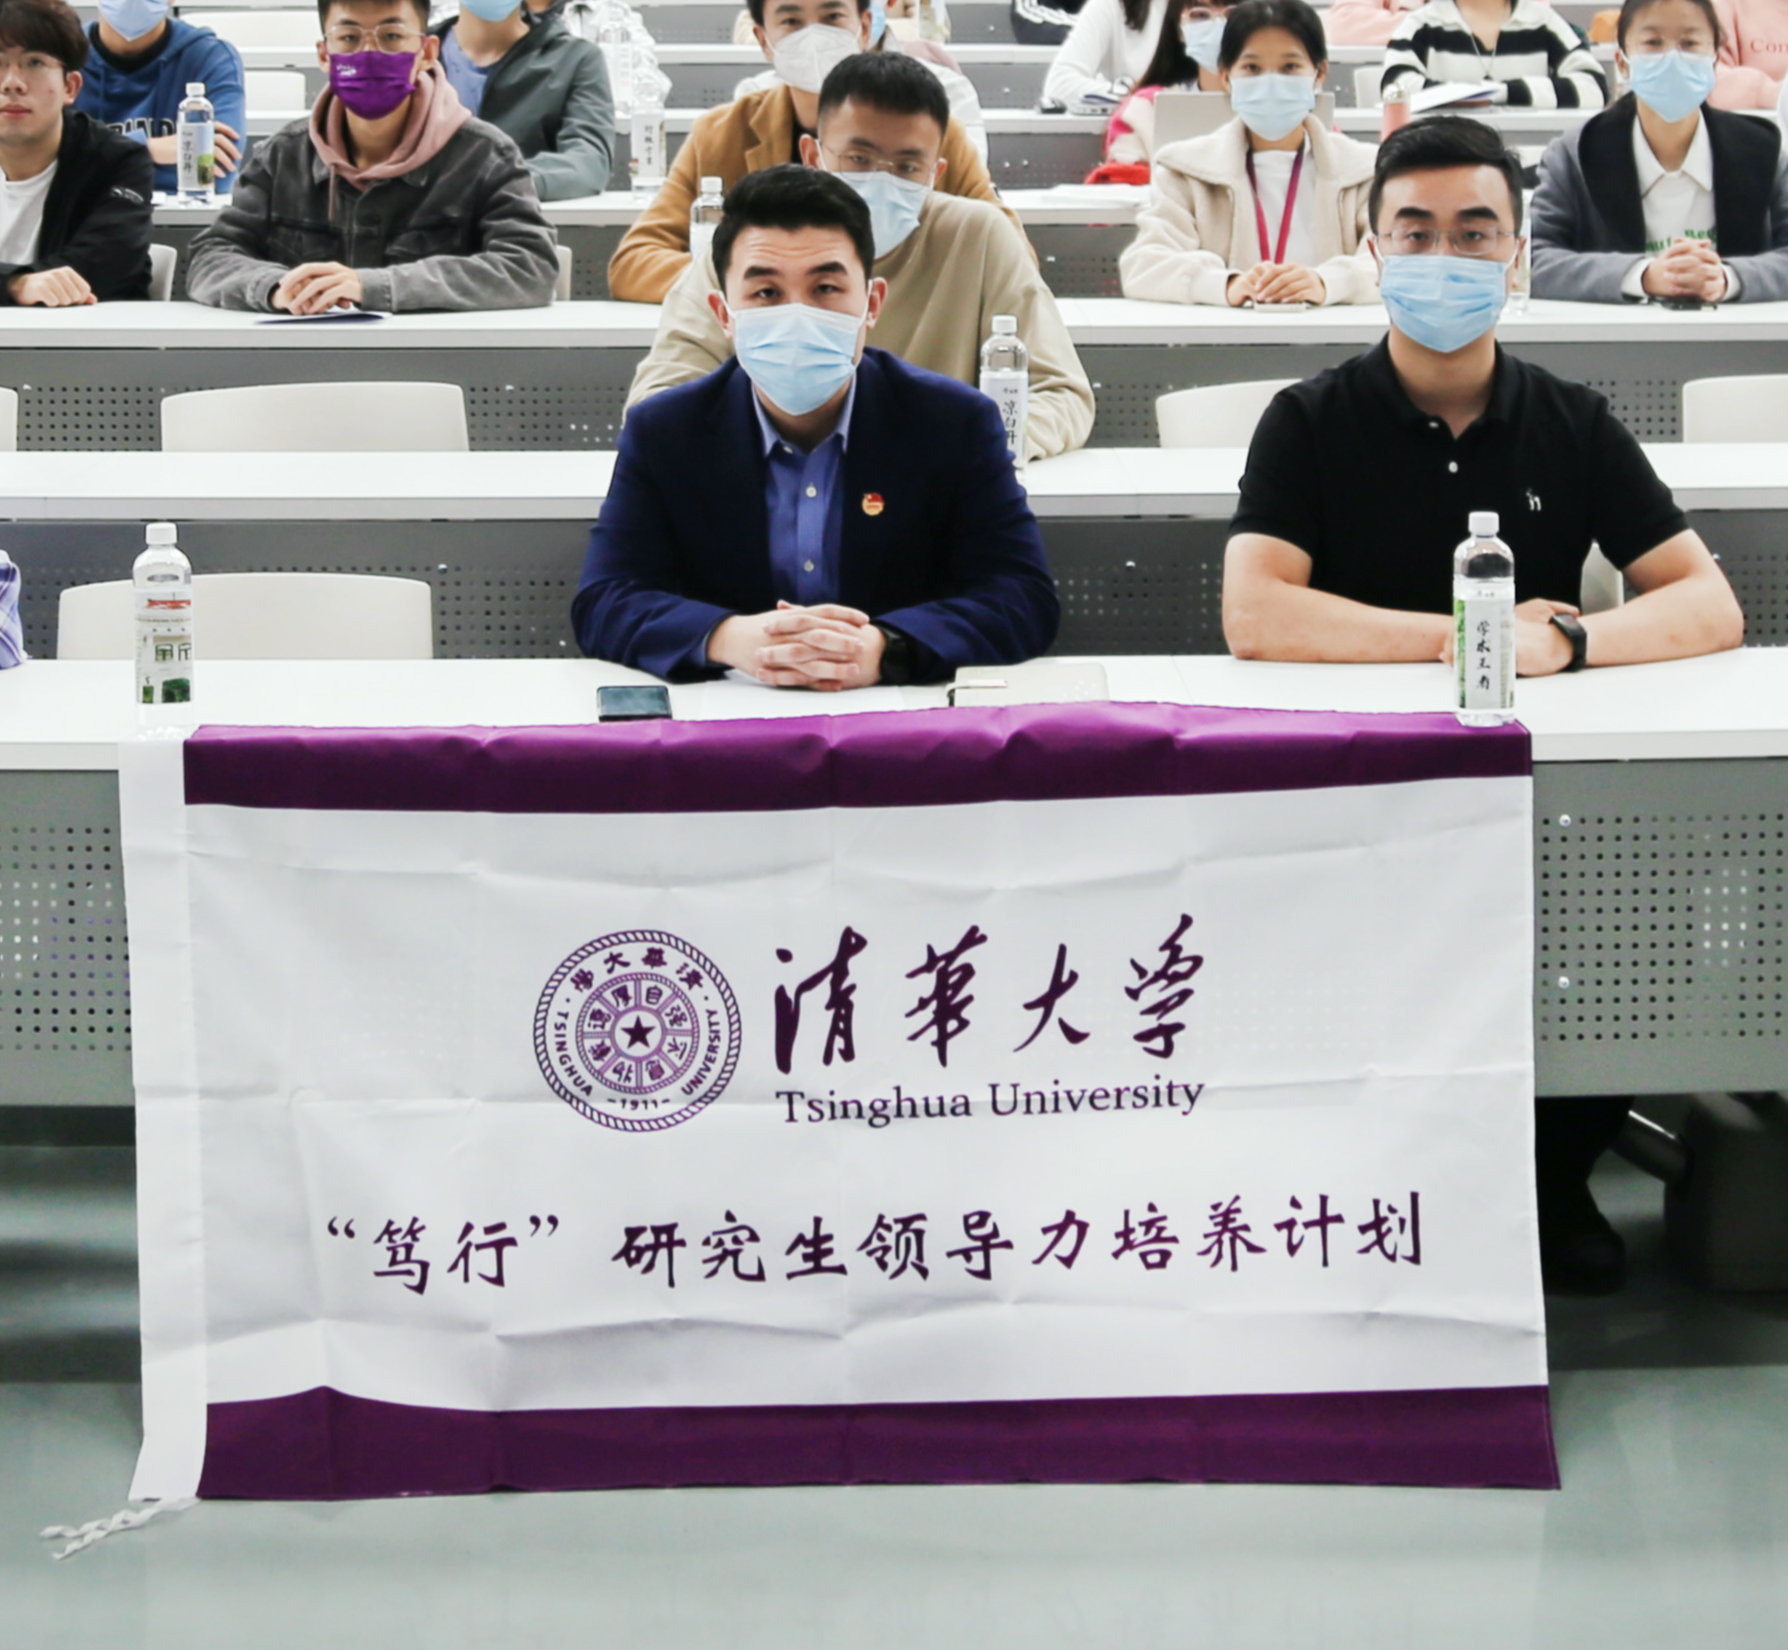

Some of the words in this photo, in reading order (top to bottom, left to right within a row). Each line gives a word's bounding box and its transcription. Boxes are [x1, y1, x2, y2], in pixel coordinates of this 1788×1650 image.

[553, 1010, 594, 1097] TSINGHUA
[680, 1008, 722, 1096] UNIVERSITY
[775, 1089, 972, 1128] Tsinghua
[989, 1073, 1205, 1118] University
[327, 1214, 560, 1295] “笃行”
[612, 1190, 1423, 1288] 研究生领导力培养计划
